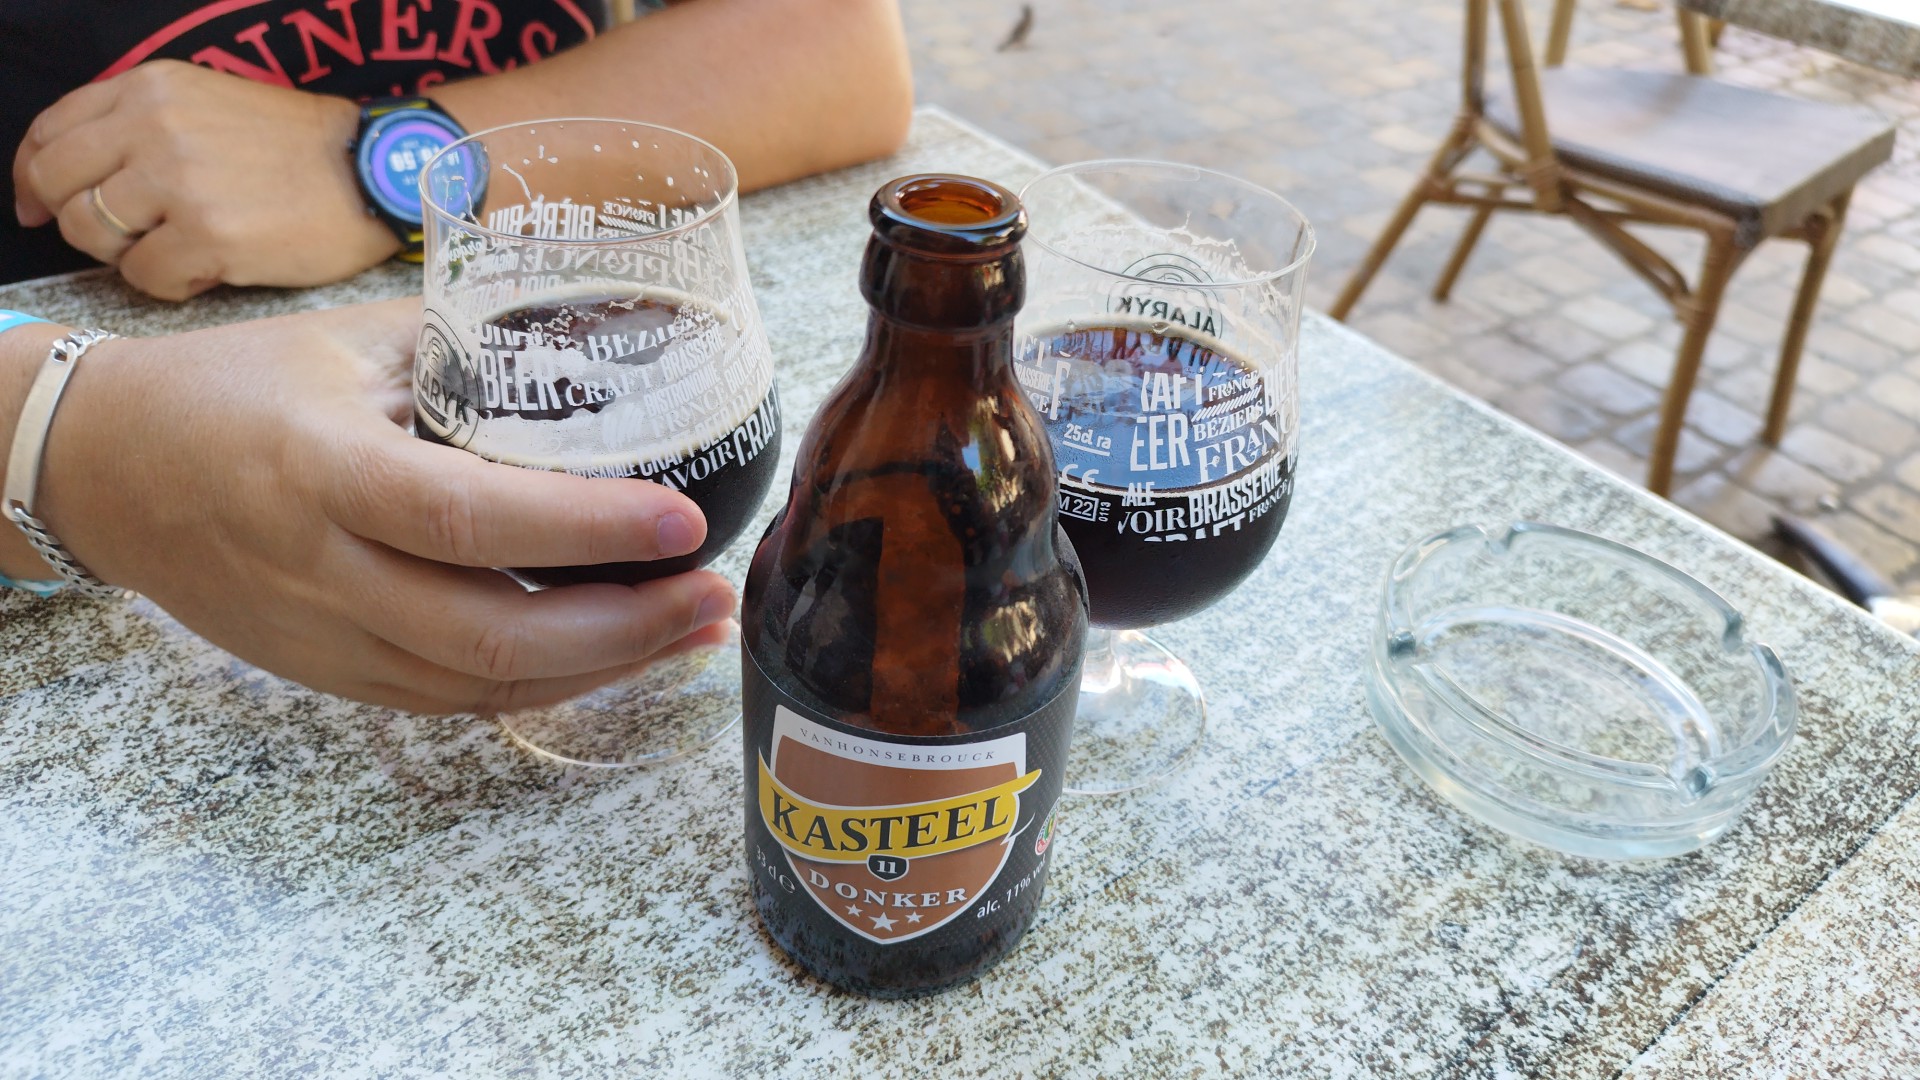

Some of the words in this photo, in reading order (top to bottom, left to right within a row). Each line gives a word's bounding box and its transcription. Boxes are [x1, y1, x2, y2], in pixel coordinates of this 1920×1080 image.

[1208, 370, 1258, 402] FRANCE
[1188, 452, 1281, 528] BRASSERIE
[800, 728, 995, 763] VANHONSEBROUCK
[771, 786, 1009, 852] KASTEEL
[808, 868, 968, 908] DONKER
[976, 900, 1001, 919] alc.
